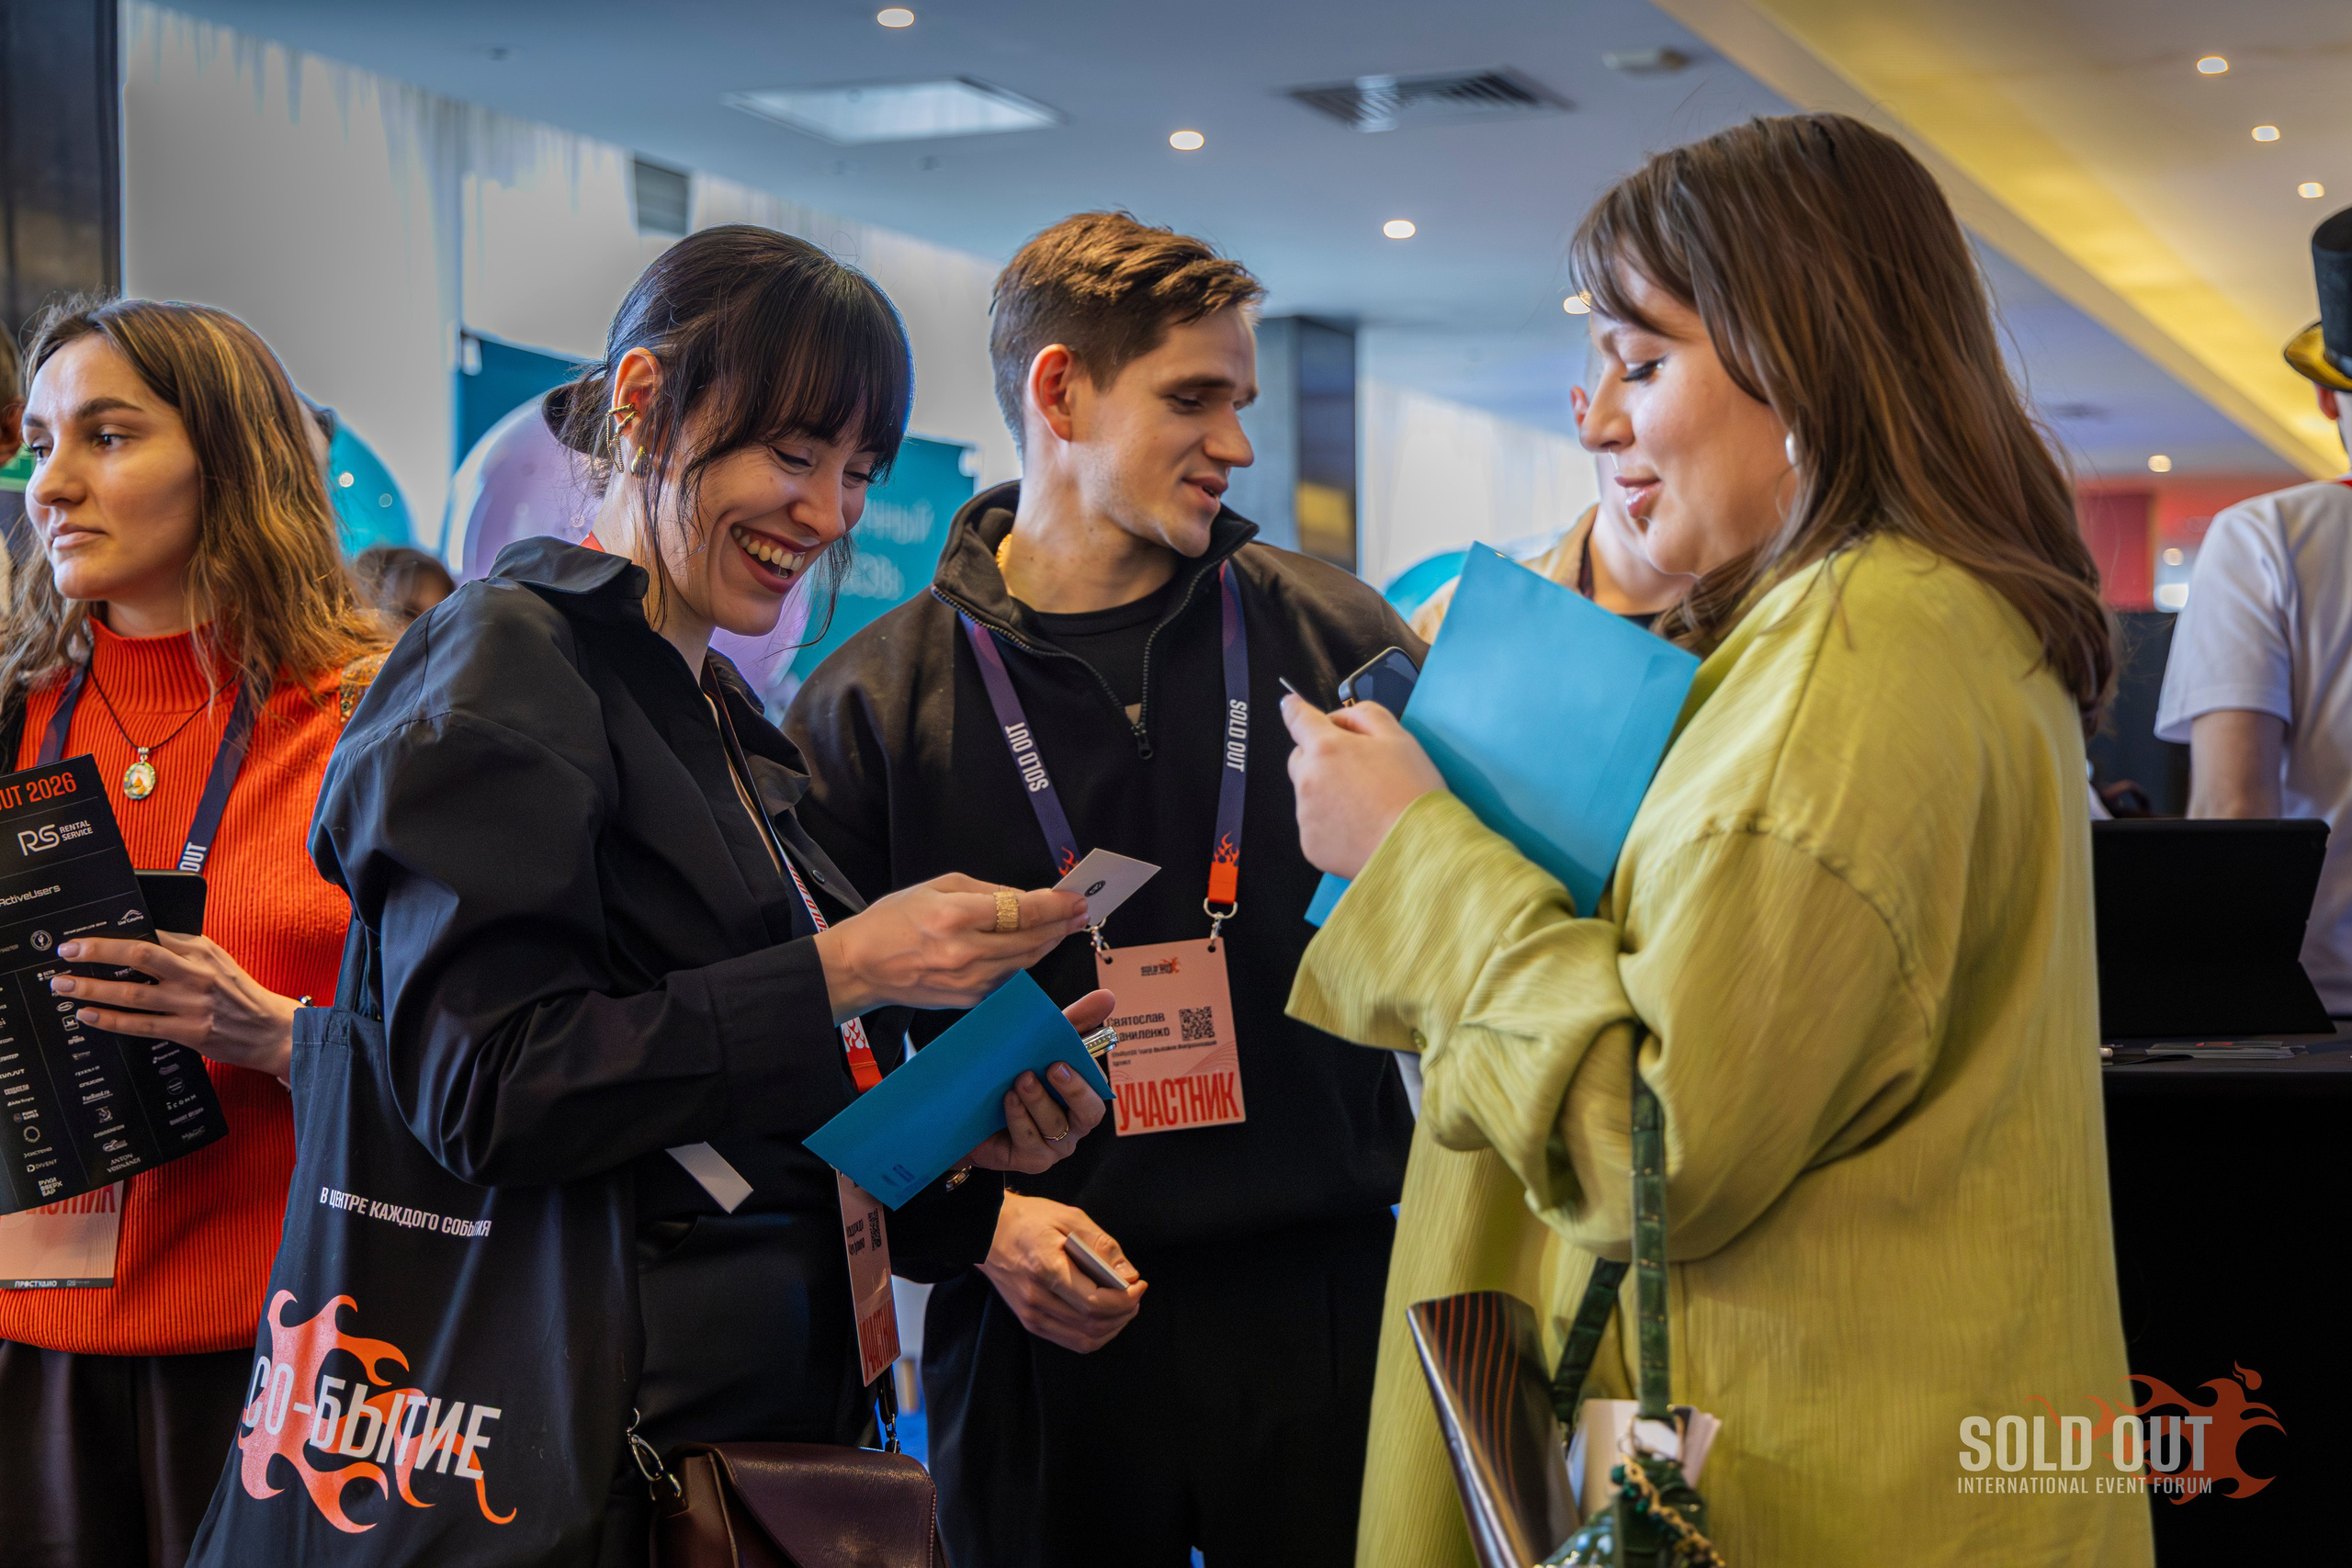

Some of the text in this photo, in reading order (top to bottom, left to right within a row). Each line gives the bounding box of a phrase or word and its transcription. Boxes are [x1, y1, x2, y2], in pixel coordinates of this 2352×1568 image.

[1227, 699, 1248, 773] SOLD OUT
[1004, 722, 1049, 793] SOLD OUT
[0, 773, 77, 810] UT 2026
[59, 819, 91, 834] RENTAL
[62, 826, 94, 841] SERVICE
[179, 841, 208, 874] OUT
[806, 897, 829, 932] OLD
[1107, 1012, 1166, 1027] Святослав
[1115, 1027, 1170, 1043] аниленко
[1114, 1071, 1239, 1132] УЧАСТНИК
[320, 1187, 329, 1204] В
[329, 1190, 369, 1214] ЦЕНТРЕ
[369, 1201, 440, 1231] КАЖДОГО
[245, 1356, 503, 1481] СО-БЫТИЕ
